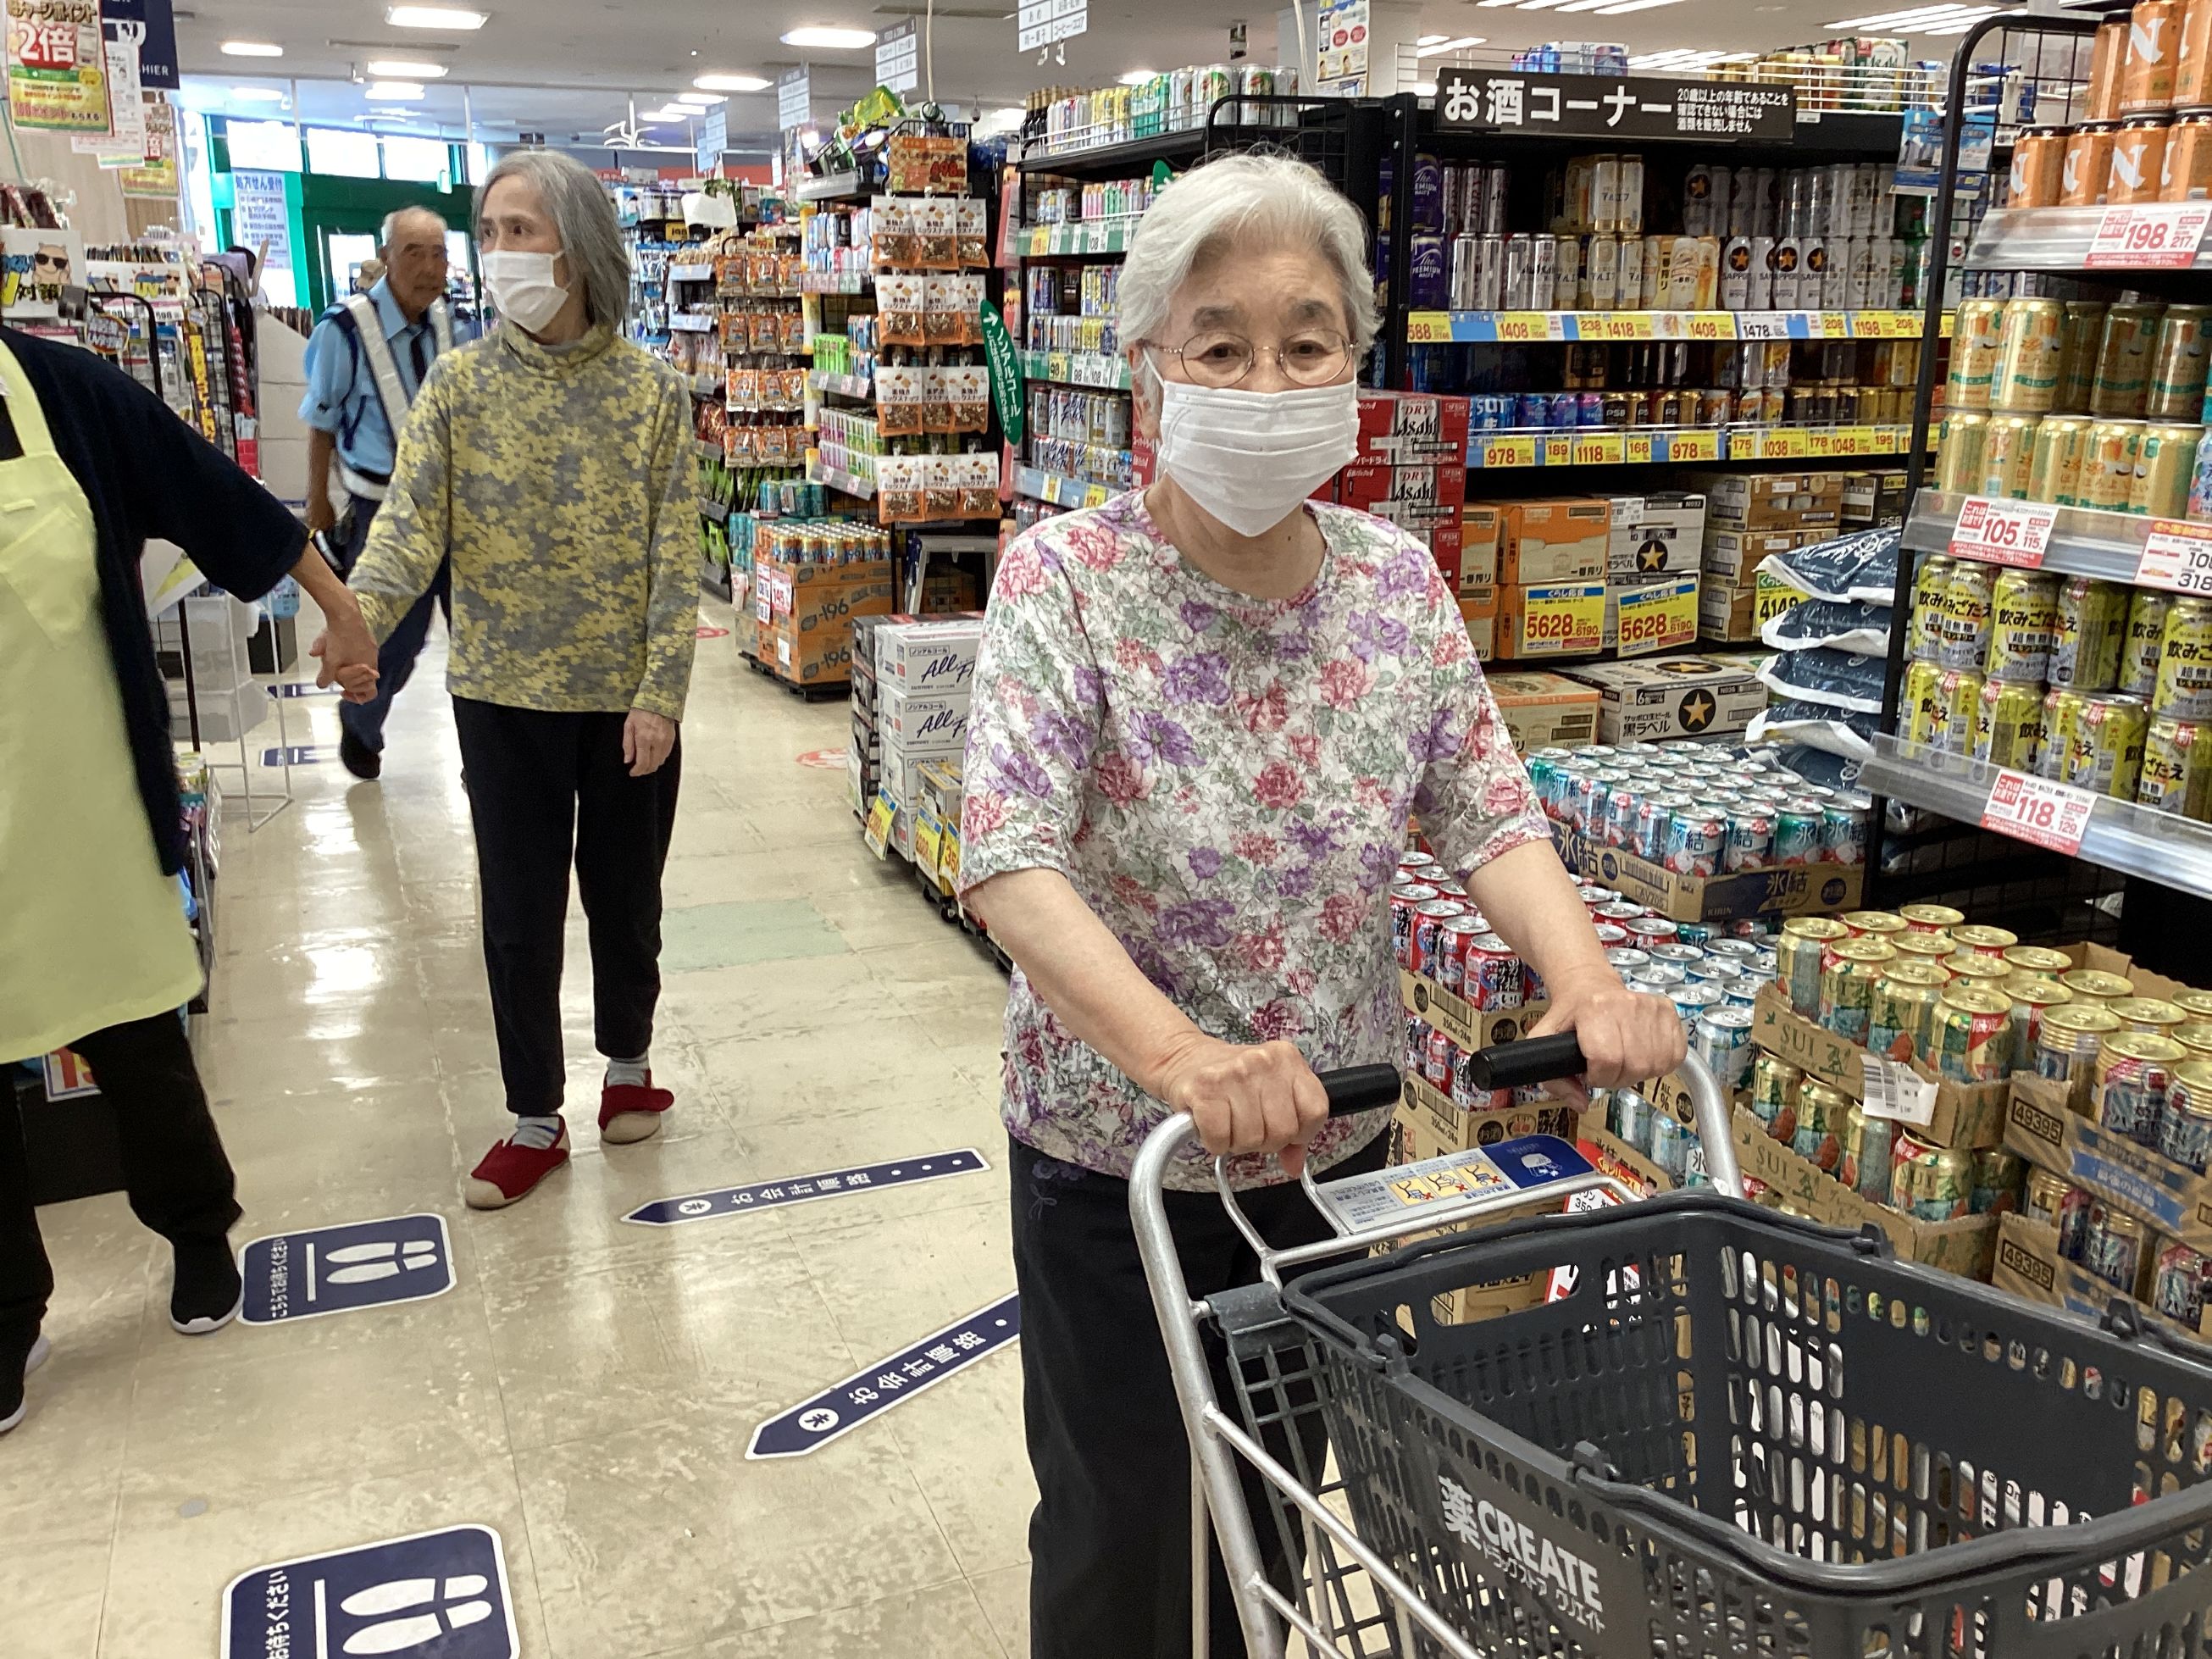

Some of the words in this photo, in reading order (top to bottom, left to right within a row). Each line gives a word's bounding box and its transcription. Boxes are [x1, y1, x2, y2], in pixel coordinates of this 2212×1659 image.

[18, 22, 75, 63] 2倍
[1444, 76, 1672, 127] お酒コーナー
[1677, 88, 1789, 106] 20歳以上の年齢であることを
[1677, 103, 1763, 119] 確認できない場合には
[1677, 117, 1753, 133] 酒類を販売しません
[236, 174, 283, 191] 処方せん受付
[2126, 223, 2168, 249] 198
[2170, 236, 2194, 248] 217
[1500, 323, 1528, 339] 1408
[1581, 320, 1601, 331] 238
[1606, 322, 1634, 338] 1418
[1690, 323, 1716, 338] 1408
[1743, 324, 1770, 337] 1478
[1824, 319, 1843, 329] 208
[1855, 321, 1880, 336] 1198
[1896, 319, 1914, 329] 208
[996, 327, 1022, 418] ノンアルコール
[1405, 405, 1430, 416] DRY
[1396, 414, 1439, 437] Asahi
[1488, 447, 1516, 465] 978
[1548, 443, 1568, 456] 189
[1577, 446, 1604, 462] 1118
[1629, 441, 1649, 454] 168
[1672, 442, 1698, 459] 978
[1733, 439, 1752, 451] 175
[1764, 441, 1788, 457] 1038
[1809, 436, 1827, 447] 178
[1832, 437, 1855, 453] 1048
[1875, 435, 1893, 446] 195
[1402, 471, 1427, 481] DRY
[1394, 480, 1434, 502] Asahi
[1879, 516, 1903, 527] PSB
[1982, 518, 2021, 546] 105
[2023, 535, 2041, 549] 115
[1461, 573, 1492, 584] 一番搾り
[1571, 565, 1603, 577] 一番搾り
[1527, 613, 1573, 638] 5628
[1576, 625, 1598, 636] 6190
[1621, 613, 1667, 641] 5628
[1670, 620, 1692, 632] 6190
[921, 654, 959, 684] All
[917, 709, 955, 739] All
[1622, 720, 1671, 738] 黒ラベル
[1623, 711, 1671, 721] サッポロ生ビール
[2176, 723, 2195, 746] 新
[2016, 796, 2055, 827] 118
[2059, 820, 2077, 835] 129
[1766, 871, 1808, 896] 氷結
[1707, 907, 1733, 917] KIRIN
[1781, 1023, 1815, 1057] SUI
[2015, 1105, 2059, 1140] 49395
[1756, 1145, 1787, 1175] SUI
[731, 1171, 872, 1205] お会計順路
[269, 1238, 288, 1318] こちらでお待ちください
[2004, 1246, 2049, 1284] 49395
[848, 1329, 987, 1405] お会計順路
[1438, 1474, 1482, 1551] 薬
[1477, 1500, 1604, 1612] CREATE
[266, 1569, 290, 1659] お待ちください
[1555, 1588, 1606, 1634] クリエイト
